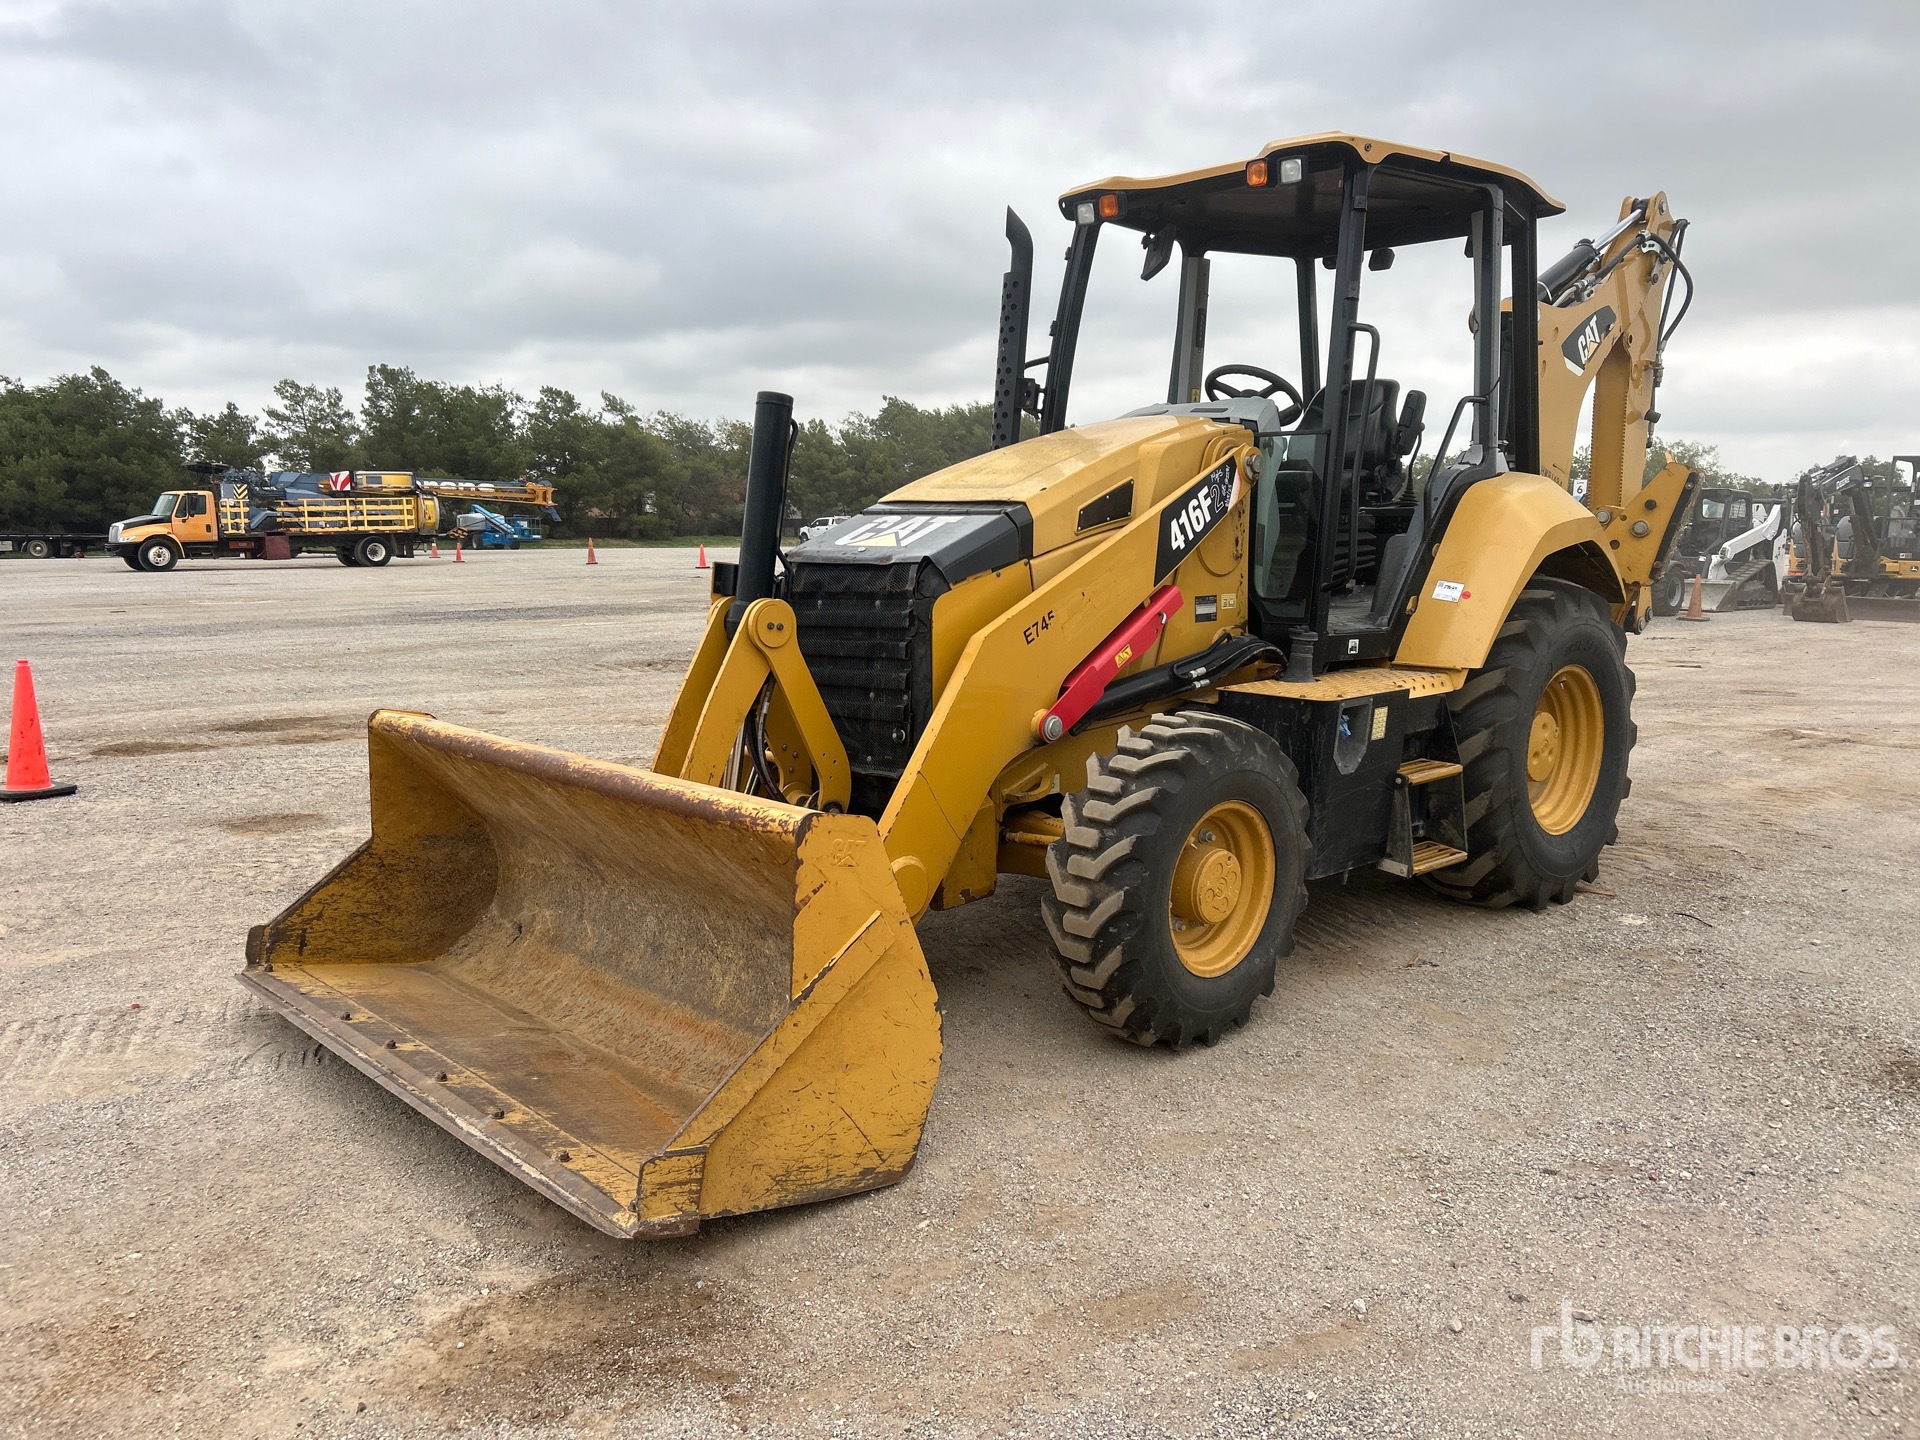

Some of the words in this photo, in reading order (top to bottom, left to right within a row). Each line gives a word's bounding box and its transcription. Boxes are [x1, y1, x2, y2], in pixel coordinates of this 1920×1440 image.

[1578, 314, 1601, 365] CAT
[1576, 485, 1583, 494] 6
[834, 515, 965, 547] CAT
